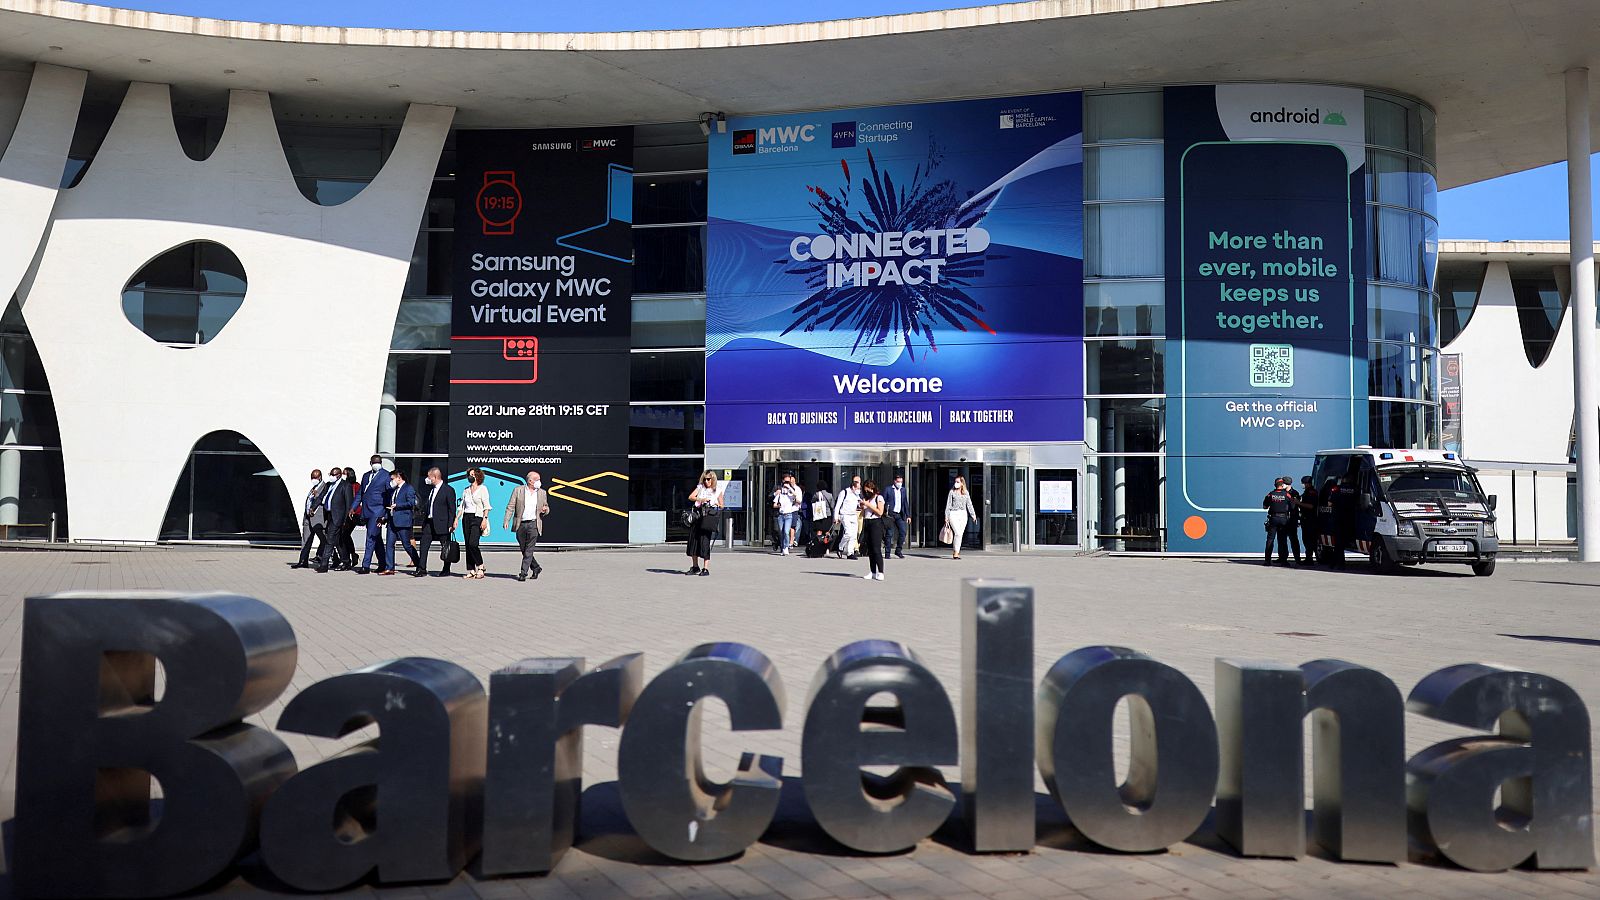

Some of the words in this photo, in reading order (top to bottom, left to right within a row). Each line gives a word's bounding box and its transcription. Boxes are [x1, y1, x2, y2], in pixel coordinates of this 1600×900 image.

[1250, 107, 1320, 125] android
[858, 120, 913, 132] Connecting
[833, 131, 855, 139] 4YFN
[858, 134, 898, 143] Startups
[532, 142, 572, 151] SAMSUNG
[593, 139, 616, 148] MWC
[758, 145, 799, 154] Barcelona
[483, 196, 515, 209] 19:15
[790, 227, 990, 262] CONNECTED
[1208, 231, 1267, 250] More
[1272, 230, 1323, 250] than
[470, 253, 575, 276] Samsung
[1198, 262, 1256, 279] ever,
[1262, 257, 1338, 277] mobile
[826, 258, 947, 288] IMPACT
[470, 279, 550, 302] Galaxy
[556, 278, 612, 297] MWC
[1220, 283, 1289, 306] keeps
[1295, 287, 1320, 302] us
[470, 304, 541, 323] Virtual
[547, 303, 606, 323] Event
[1216, 309, 1324, 333] together.
[833, 374, 943, 394] Welcome
[467, 404, 493, 416] 2021
[496, 404, 527, 416] June
[528, 404, 556, 416] 28th
[558, 404, 584, 416] 19:15
[585, 404, 610, 416] CET
[1225, 400, 1249, 412] Get
[1251, 400, 1273, 412] the
[1275, 400, 1318, 412] official
[767, 411, 787, 424] BACK
[788, 411, 798, 424] TO
[800, 411, 838, 424] BUSINESS
[854, 411, 875, 424] BACK
[876, 411, 886, 423] TO
[887, 410, 933, 423] BARCELONA
[949, 410, 971, 423] BACK
[972, 409, 1014, 423] TOGETHER
[1240, 416, 1275, 428] MWC
[1277, 419, 1305, 430] app.
[466, 430, 487, 439] How
[487, 430, 497, 439] to
[497, 429, 513, 440] join
[466, 444, 573, 453] www.youtube.com/samsung
[466, 456, 562, 464] www.mwcbarcelona.com
[10, 578, 1592, 898] Barcelona
